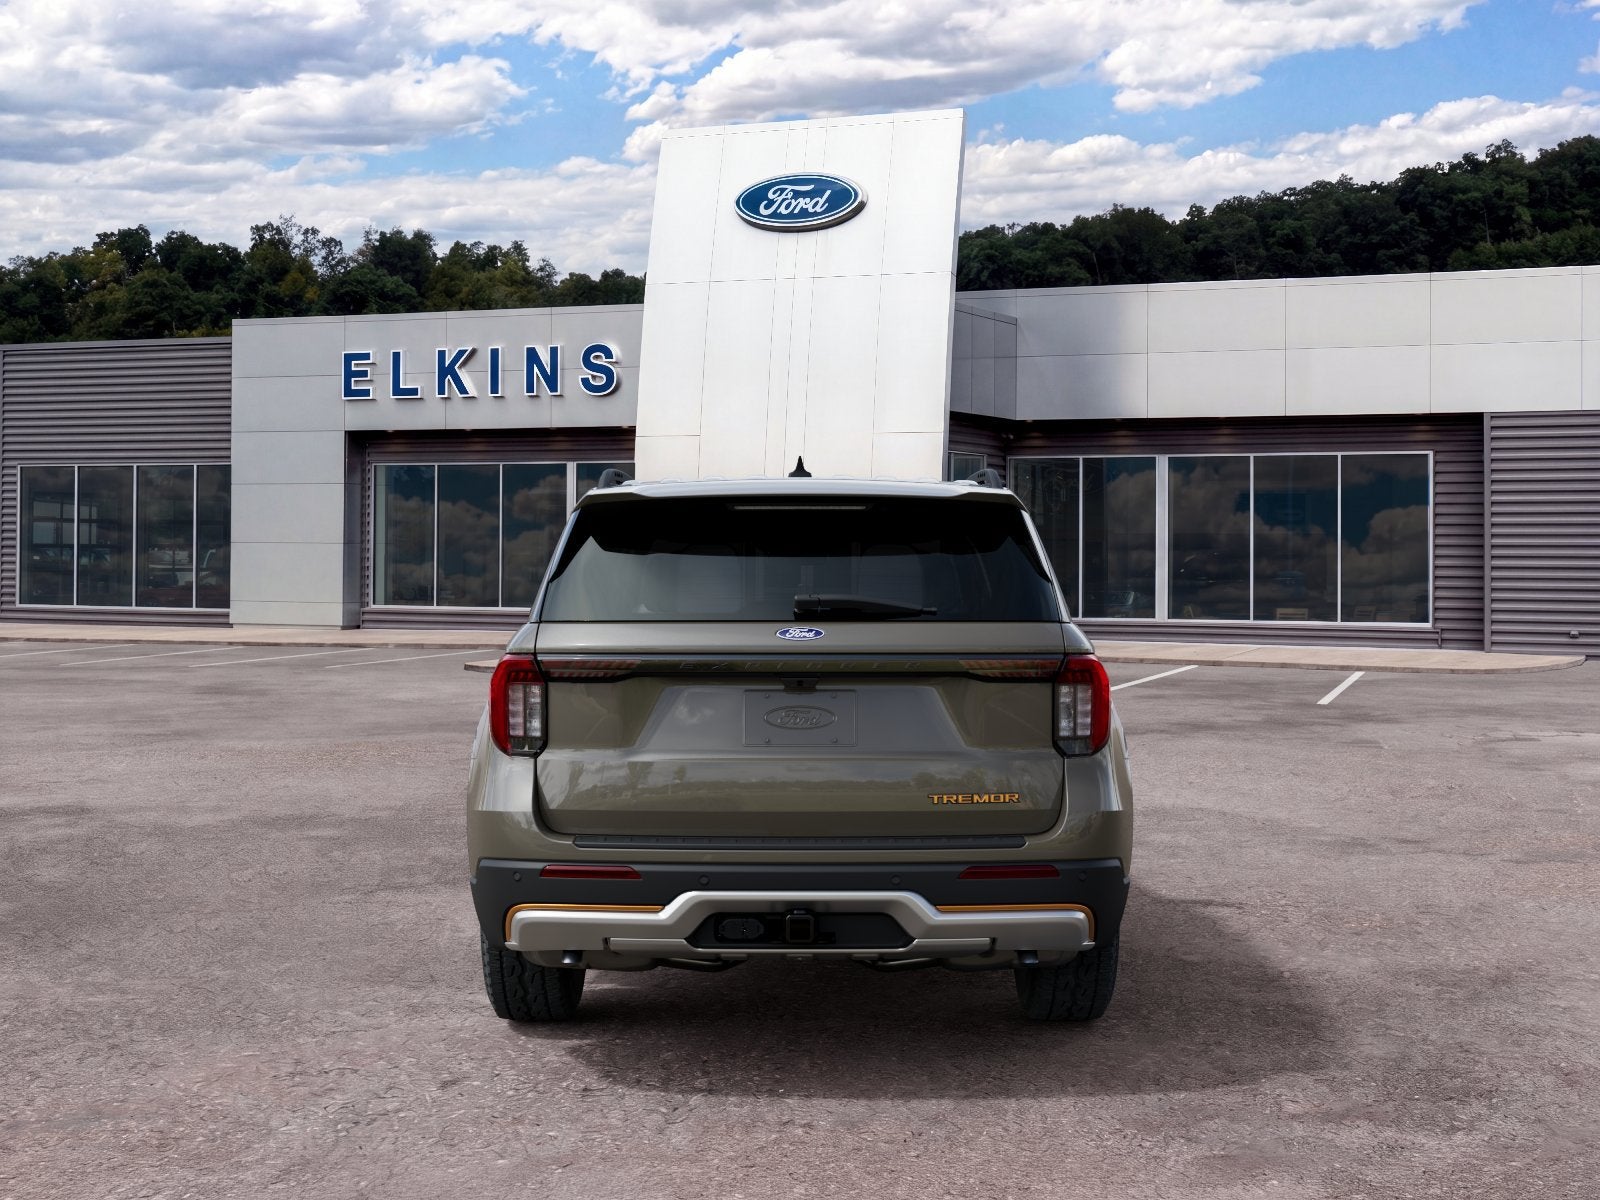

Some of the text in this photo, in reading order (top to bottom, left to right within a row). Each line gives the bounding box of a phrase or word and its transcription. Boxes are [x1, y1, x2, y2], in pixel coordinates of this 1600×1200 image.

[760, 184, 832, 215] Ford
[342, 343, 618, 400] ELKINS
[786, 628, 816, 638] Ford
[776, 709, 823, 726] Ford
[928, 793, 1020, 804] TREMOR
